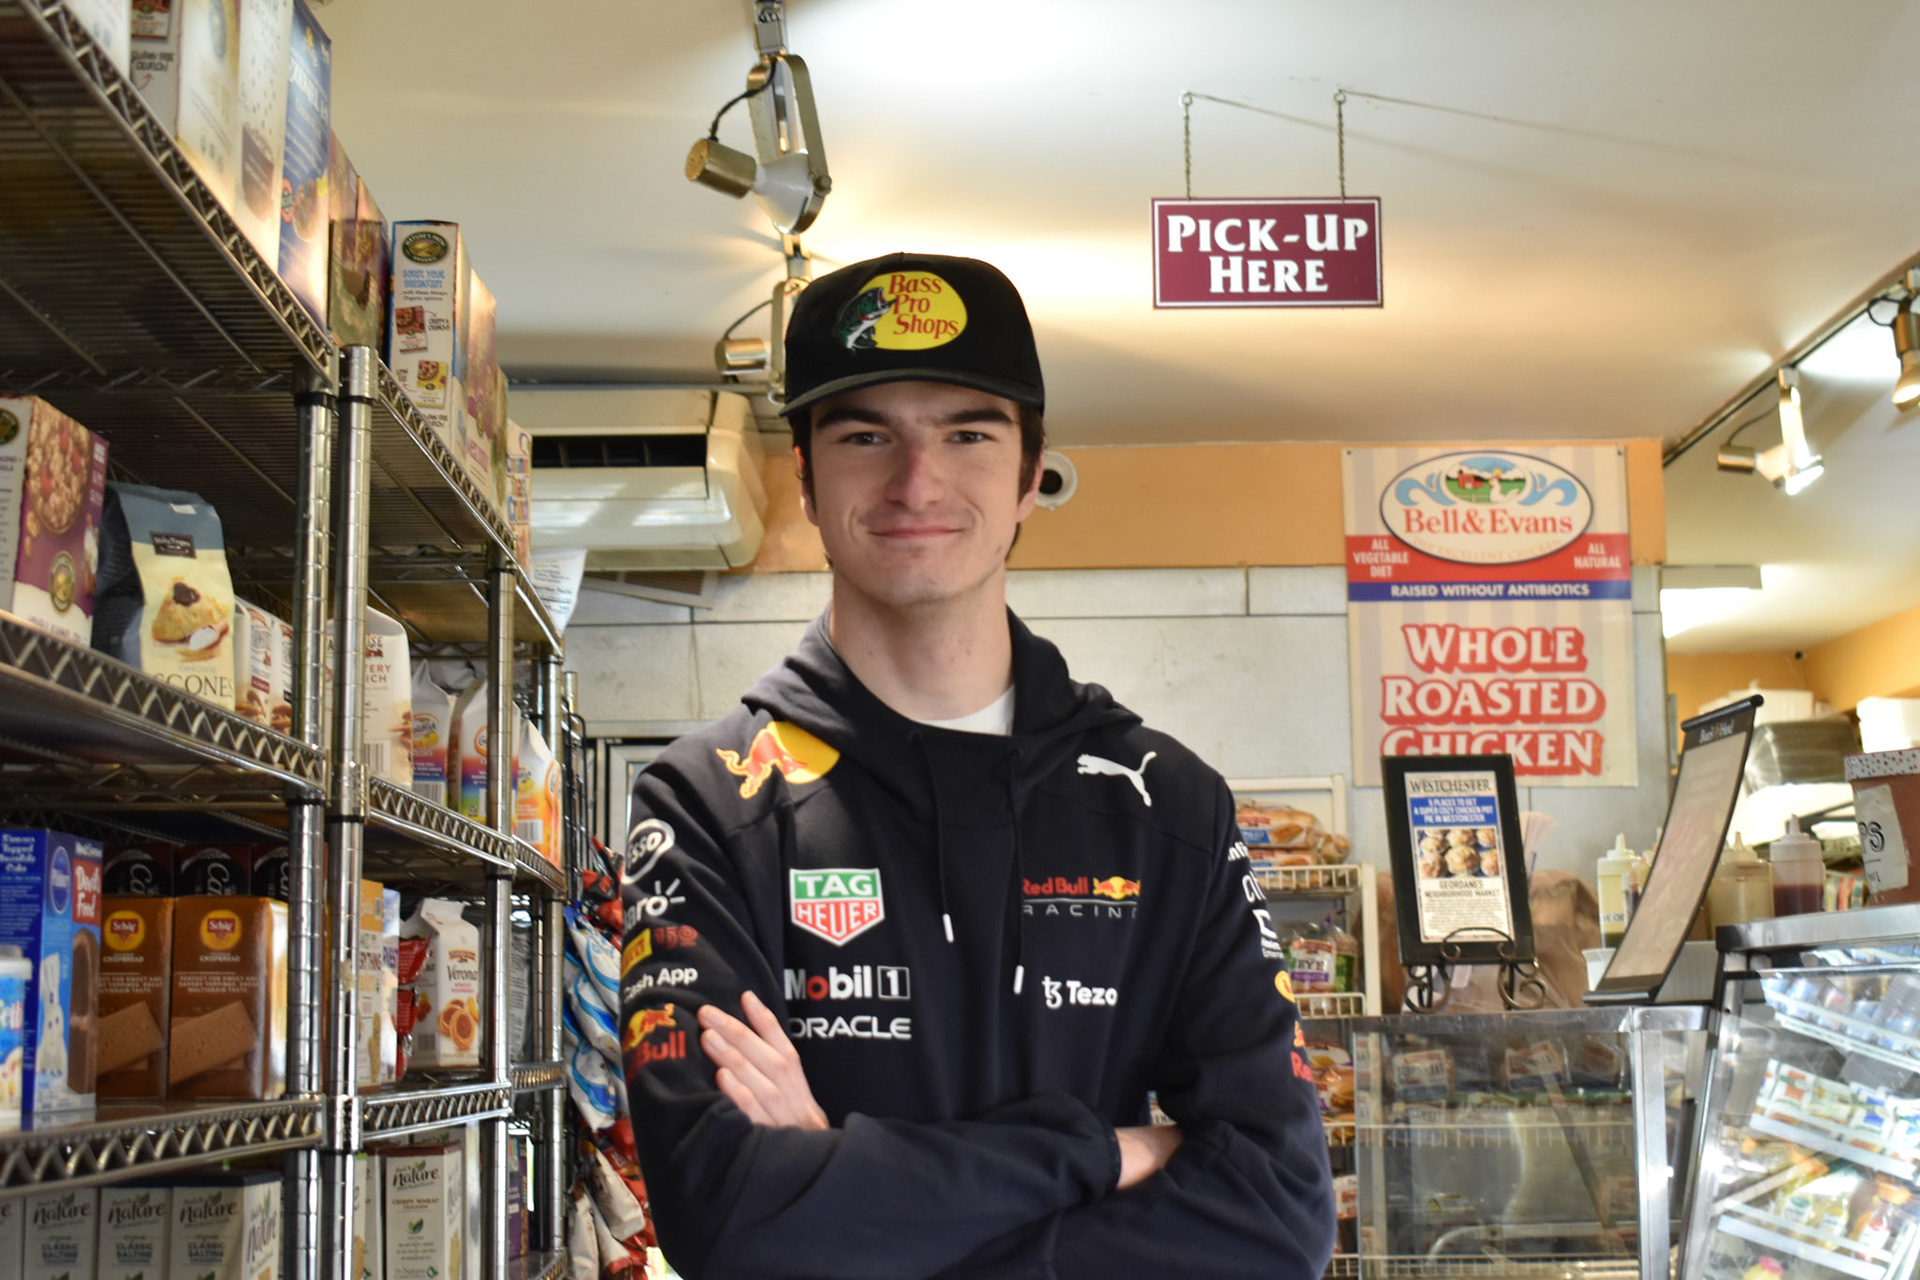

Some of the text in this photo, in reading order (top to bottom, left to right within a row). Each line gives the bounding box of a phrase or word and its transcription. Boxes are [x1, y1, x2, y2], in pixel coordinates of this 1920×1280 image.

[1167, 214, 1368, 252] PICK-UP
[889, 274, 942, 294] Bass
[1209, 256, 1328, 293] HERE
[893, 293, 930, 314] Pro
[894, 314, 959, 339] Shops
[1371, 538, 1390, 550] ALL
[1588, 542, 1605, 555] ALL
[1353, 551, 1409, 564] VEGETABLE
[1574, 556, 1621, 568] NATURAL
[1370, 565, 1392, 577] DIET
[1391, 584, 1589, 597] RAISED WITHOUT ANTIBIOTICS
[1402, 625, 1587, 672] WHOLE
[1381, 676, 1606, 724] ROASTED
[1410, 779, 1492, 792] WESTCHESTER
[798, 874, 873, 897] TAG
[1055, 877, 1089, 895] Bull
[797, 902, 878, 937] HEUER
[656, 967, 698, 986] App
[784, 965, 899, 1000] Mobil 1
[788, 1015, 912, 1040] ORACLE
